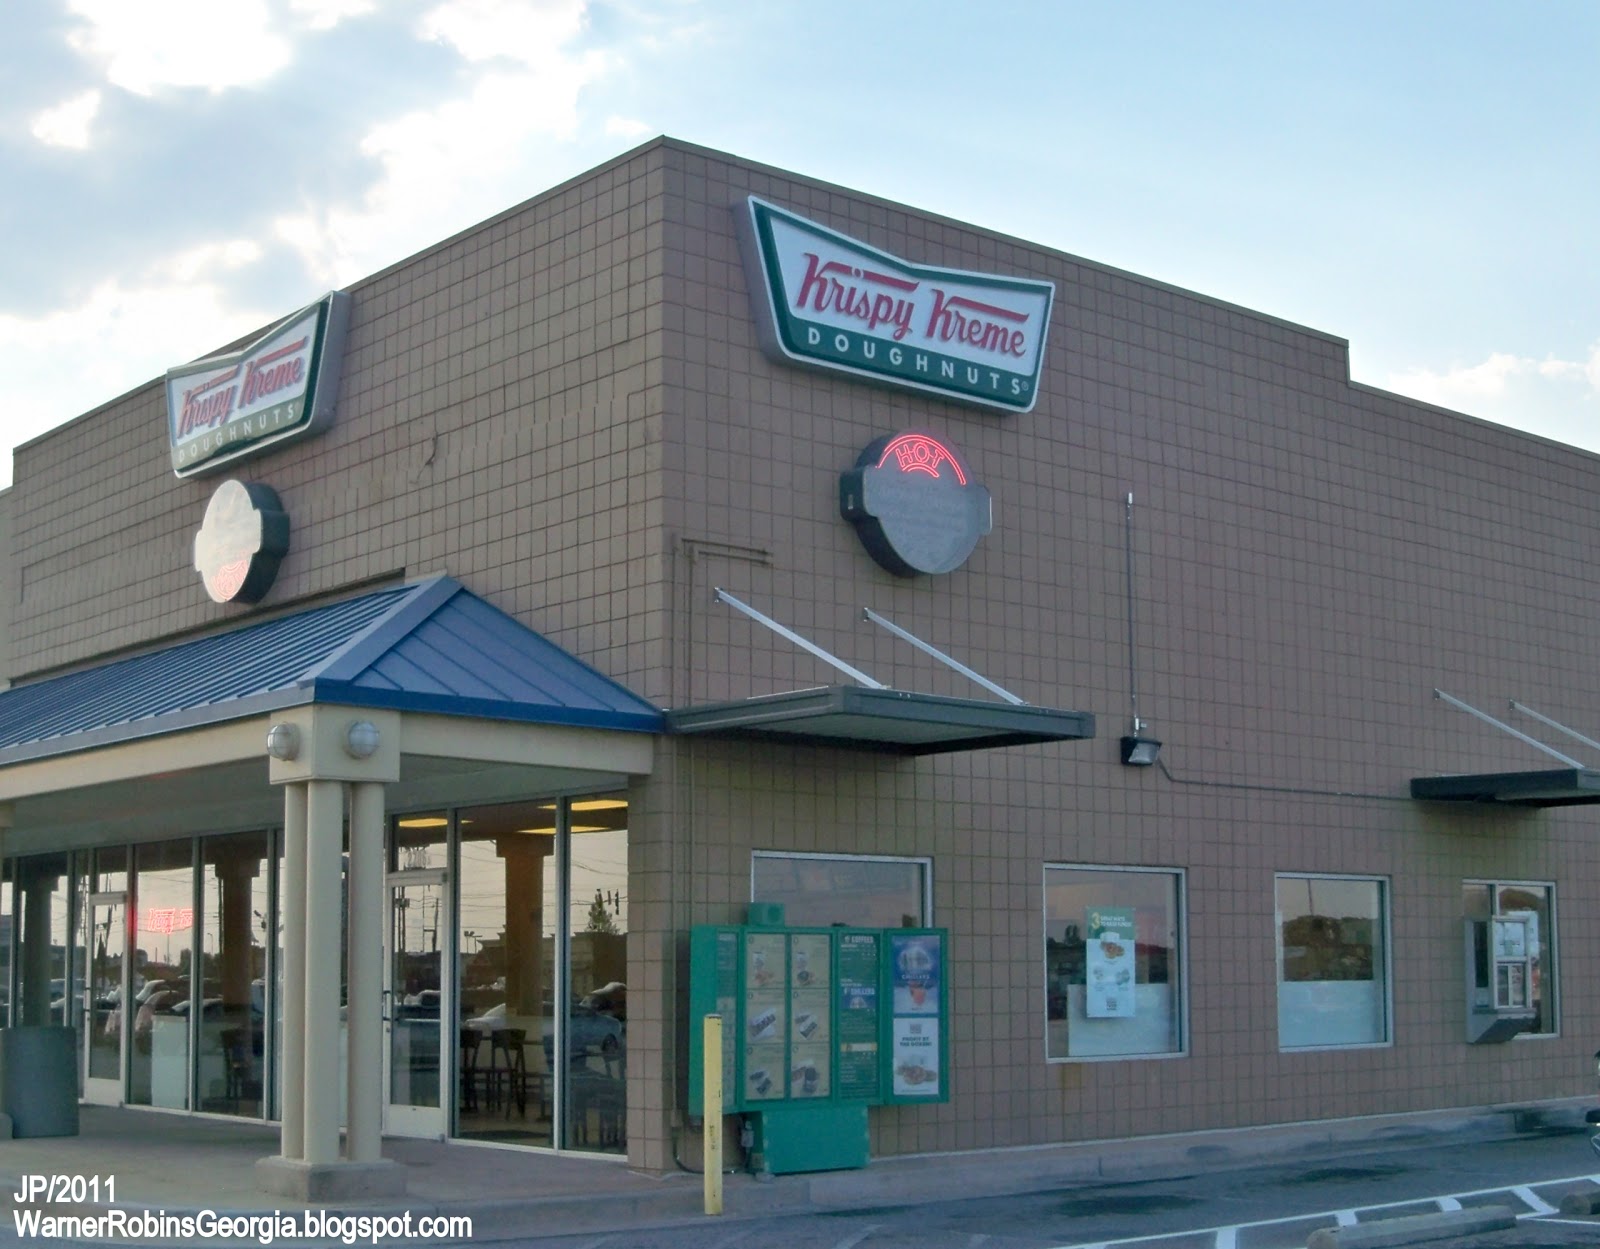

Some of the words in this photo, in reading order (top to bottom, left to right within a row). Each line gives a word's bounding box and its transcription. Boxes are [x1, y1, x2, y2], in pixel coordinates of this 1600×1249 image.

[796, 252, 920, 341] Krispy
[926, 288, 1030, 358] Kreme
[176, 364, 240, 439] Krispy
[238, 336, 308, 409] Kreme
[808, 327, 1021, 395] DOUGHNUTS
[178, 404, 296, 463] DOUGHNUTS
[895, 441, 945, 468] HOT
[1091, 911, 1101, 929] 3
